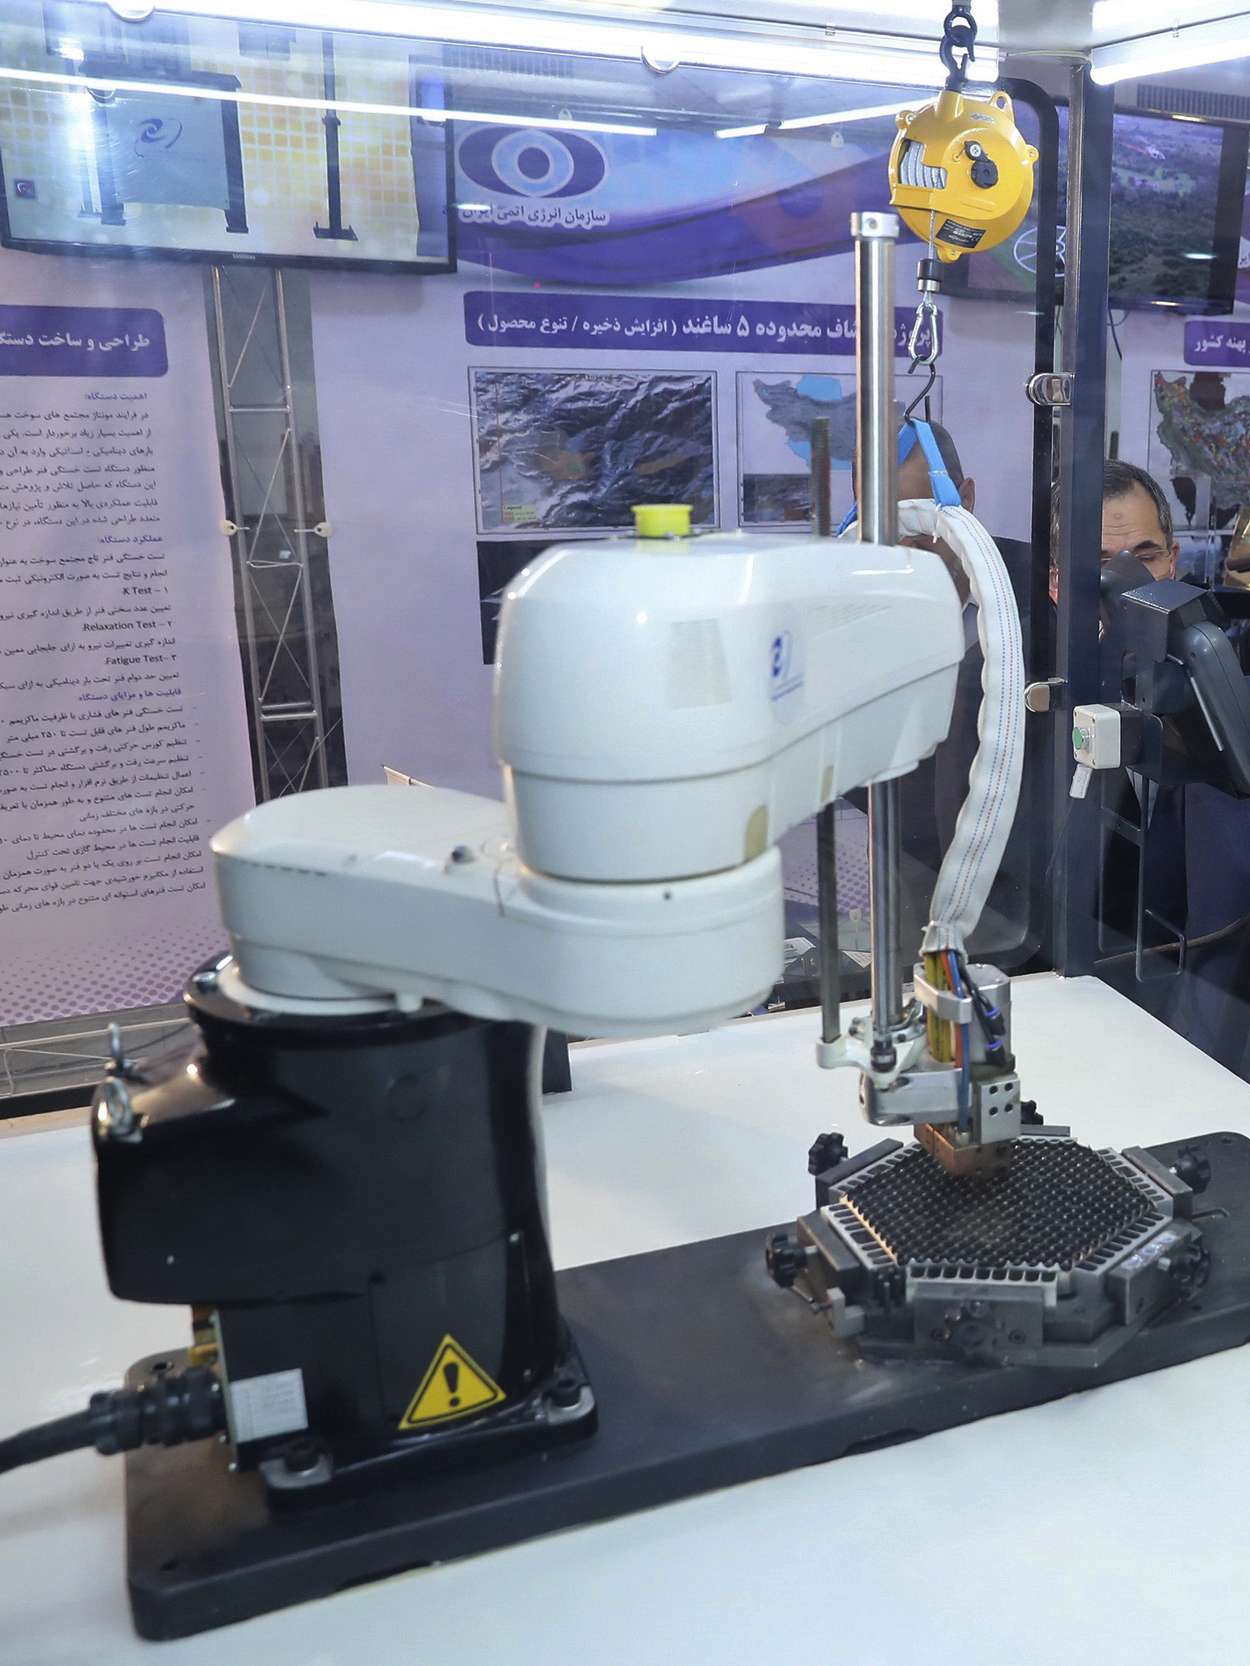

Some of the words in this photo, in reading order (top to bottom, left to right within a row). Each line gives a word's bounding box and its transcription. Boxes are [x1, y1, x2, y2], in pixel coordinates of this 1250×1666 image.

[498, 205, 524, 220] اتمی
[528, 207, 560, 222] انرژی
[565, 209, 605, 224] سازمان
[488, 314, 535, 333] محصول
[540, 316, 567, 334] تنوع
[583, 317, 620, 335] ذخیره
[625, 318, 667, 336] افزایش
[683, 316, 731, 334] ساغند
[737, 316, 749, 336] ۵
[756, 319, 822, 342] محدوده
[39, 332, 82, 347] ساخت
[88, 340, 94, 350] و
[100, 334, 149, 350] طراحی
[1194, 334, 1224, 352] کشور
[1226, 336, 1246, 354] پهنه
